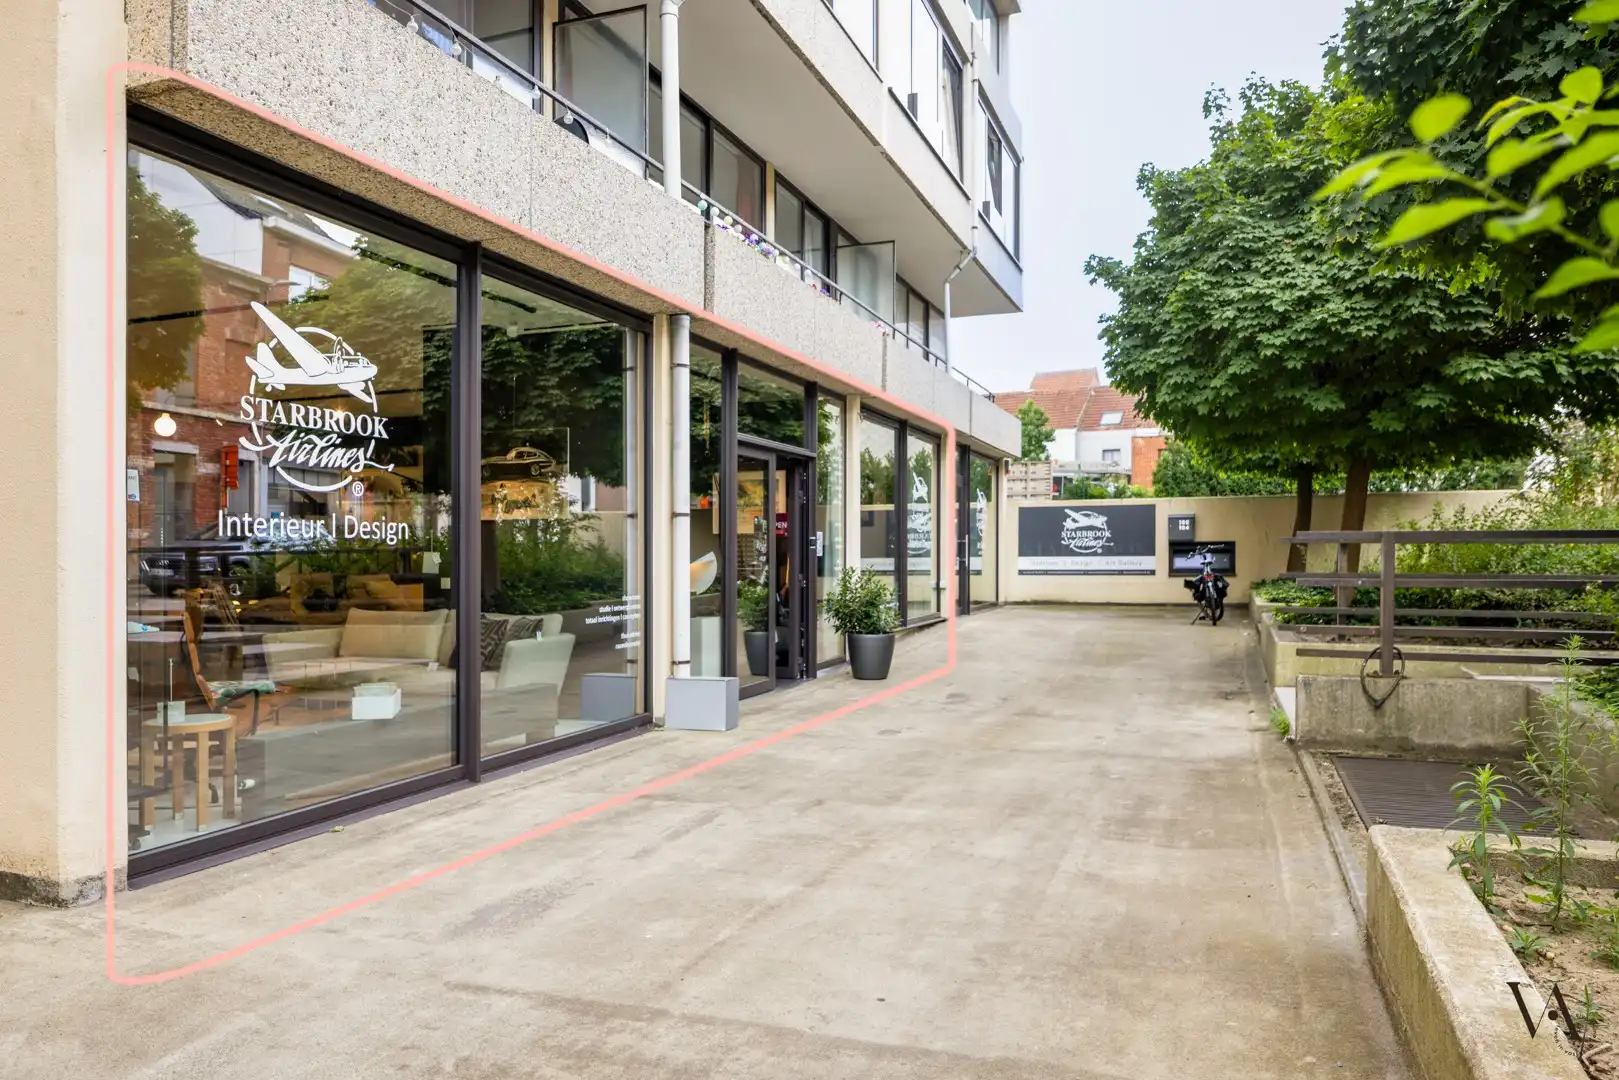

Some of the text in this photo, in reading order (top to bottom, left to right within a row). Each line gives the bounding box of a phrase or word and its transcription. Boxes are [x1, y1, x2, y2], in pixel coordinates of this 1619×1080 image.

[240, 395, 389, 440] STARBROOK
[218, 509, 324, 538] Interieur
[344, 515, 409, 545] Design
[1061, 530, 1112, 538] STARBROOK
